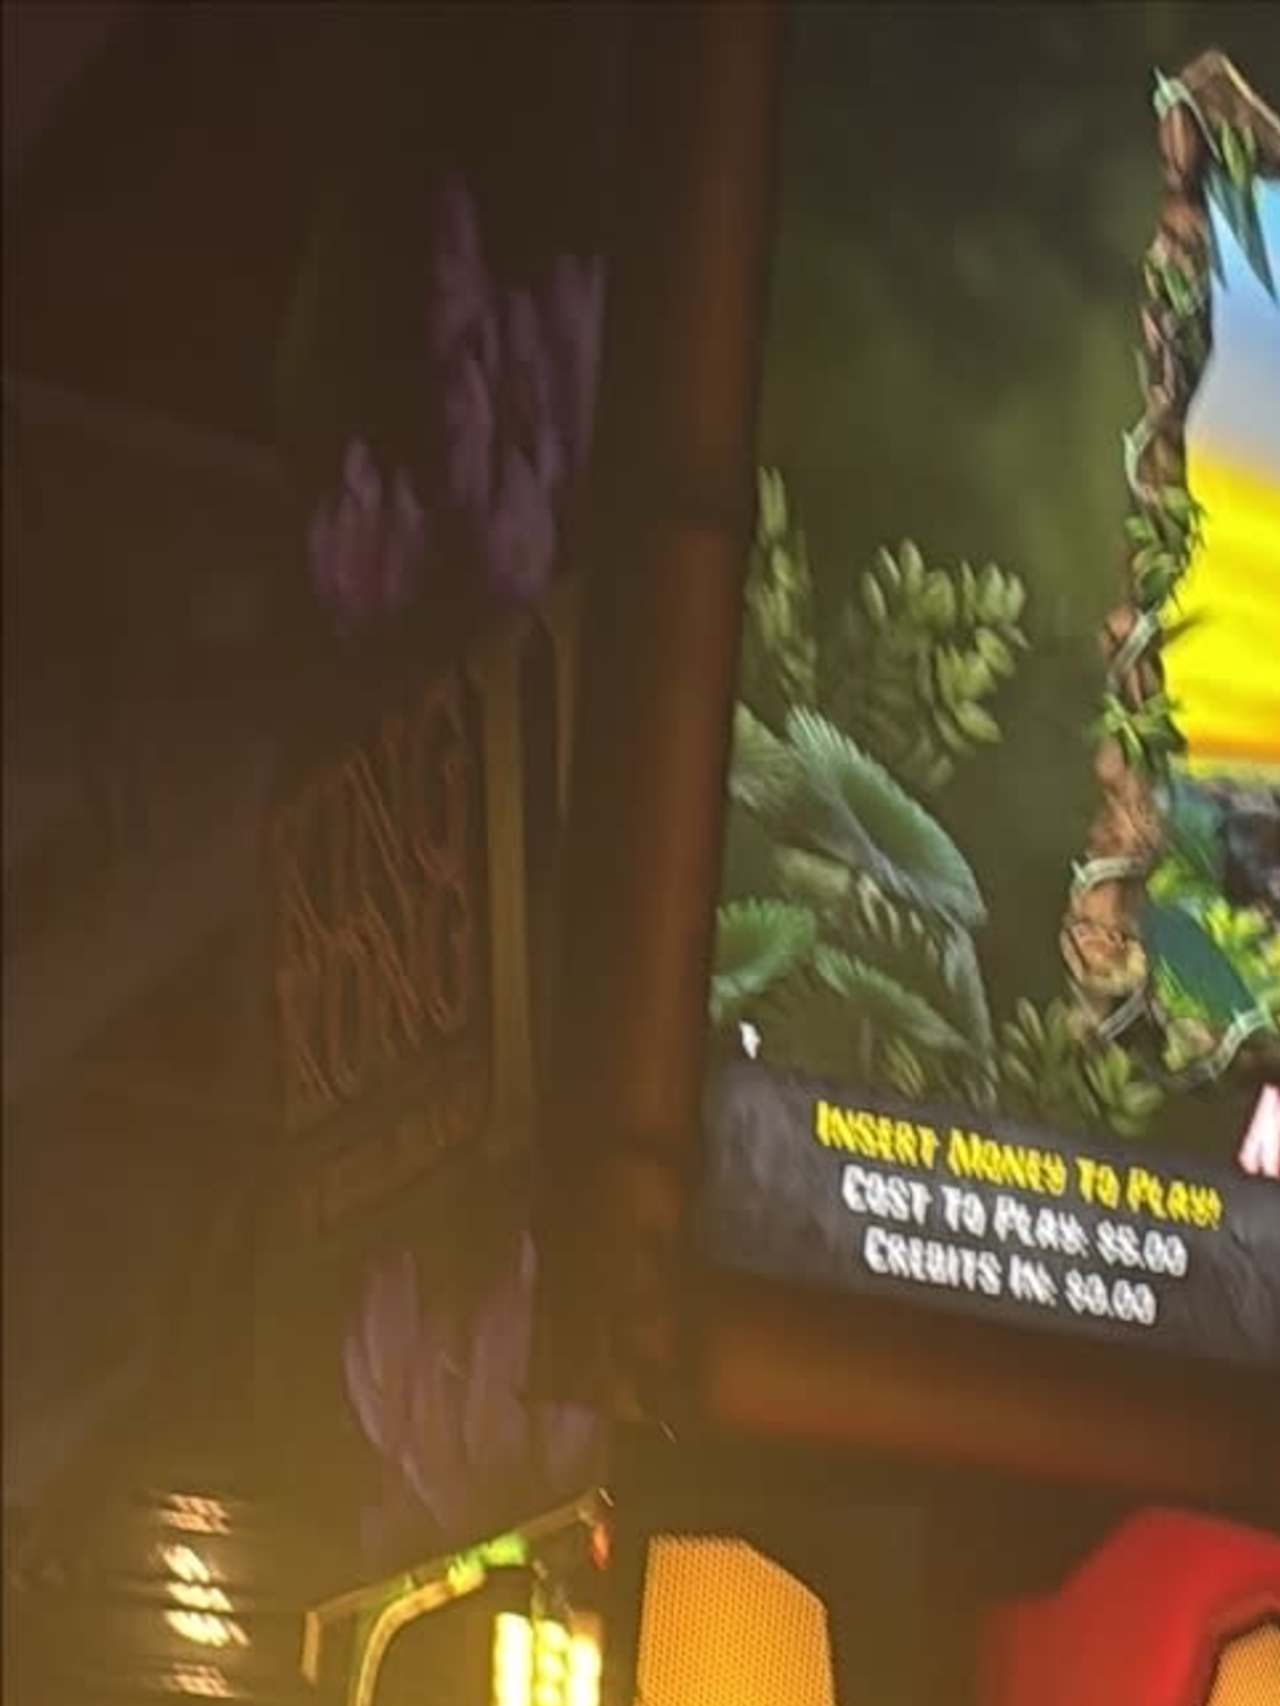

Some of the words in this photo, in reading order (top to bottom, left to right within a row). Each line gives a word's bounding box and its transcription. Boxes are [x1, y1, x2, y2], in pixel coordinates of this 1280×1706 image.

[815, 1099, 940, 1169] INSERT
[948, 1127, 1067, 1196] MONEY
[1076, 1158, 1119, 1209] TO
[1126, 1167, 1223, 1231] PLAY!
[842, 1164, 932, 1223] COST
[941, 1184, 986, 1237] TO
[864, 1226, 1002, 1295] CREDITS
[1065, 1269, 1158, 1326] $0.00
